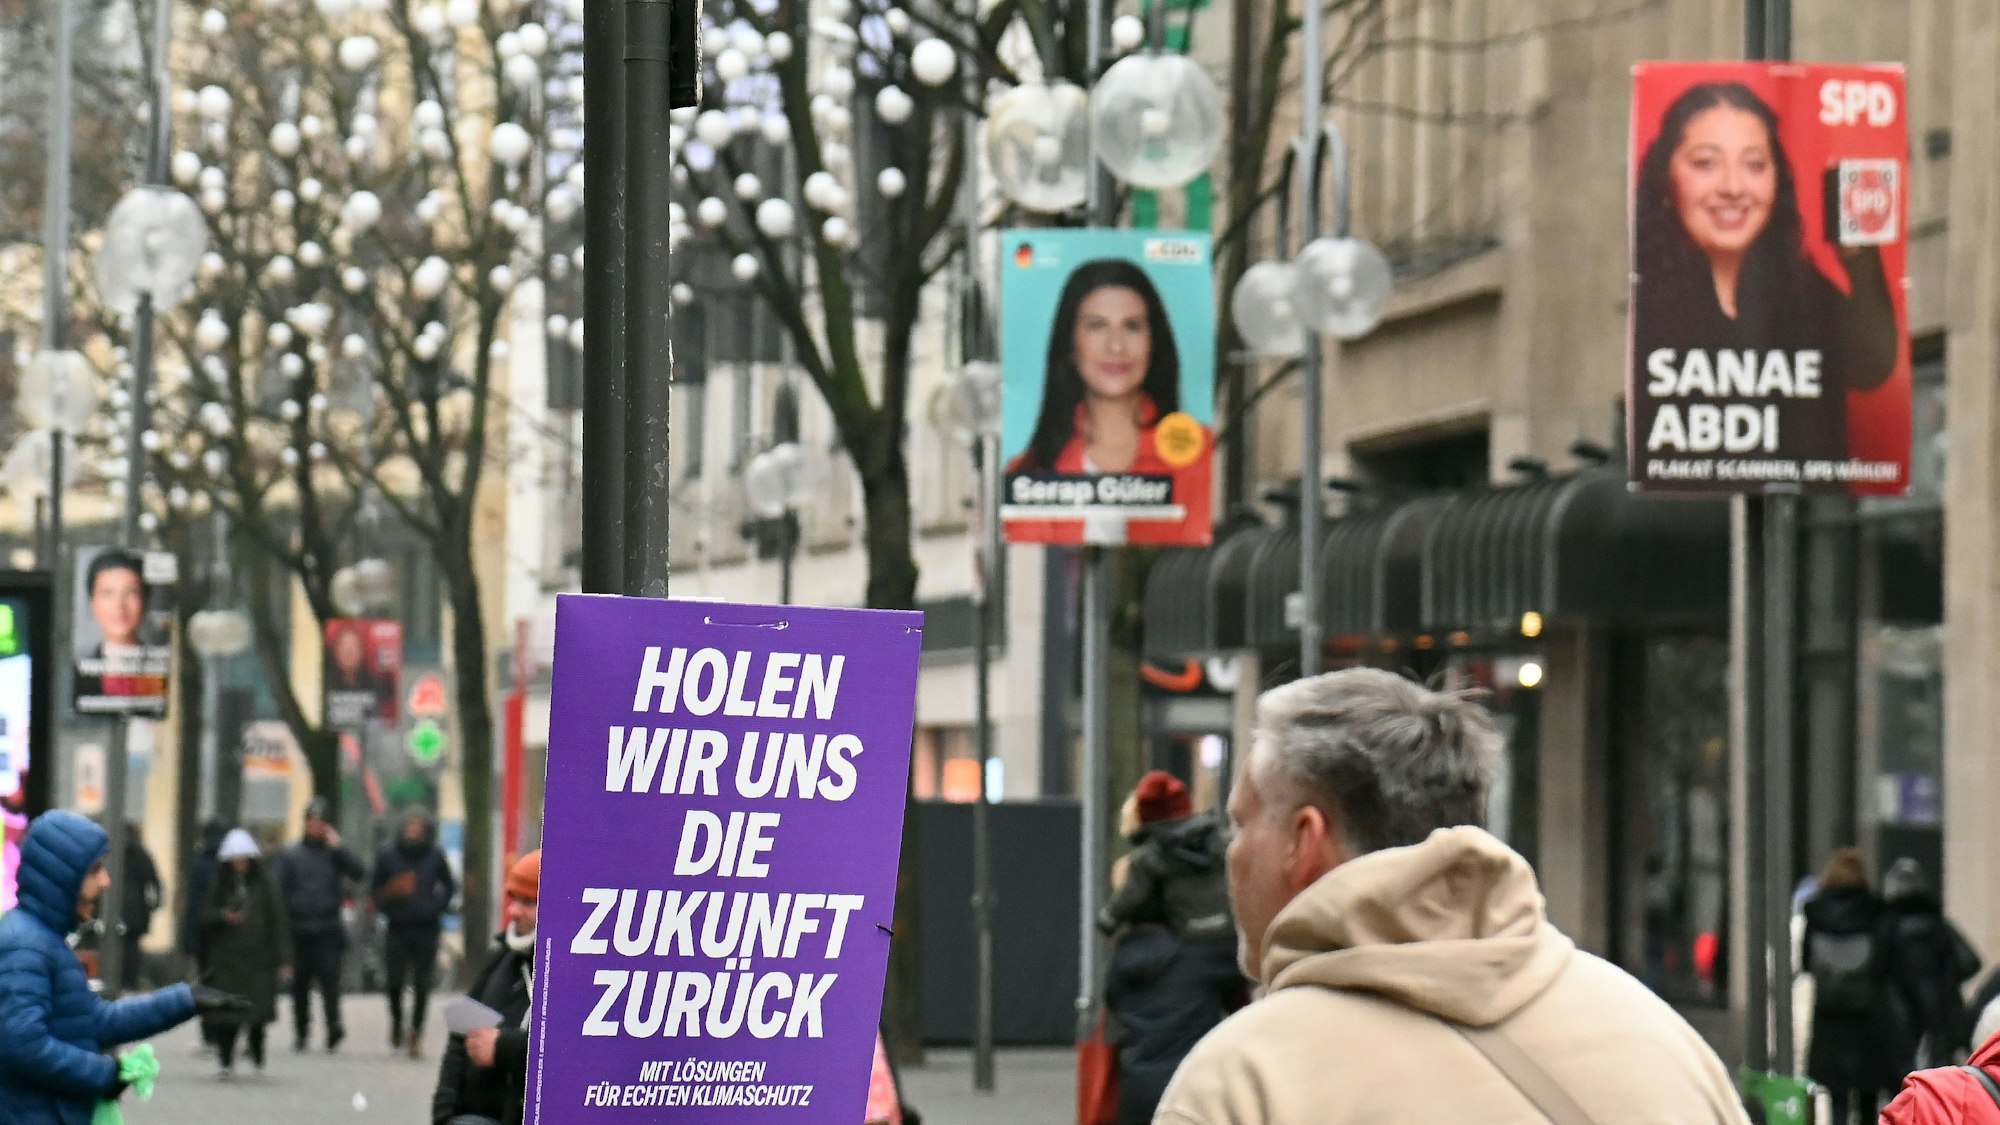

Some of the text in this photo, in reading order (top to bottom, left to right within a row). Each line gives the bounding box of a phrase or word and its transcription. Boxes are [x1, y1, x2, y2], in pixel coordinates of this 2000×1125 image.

[1819, 80, 1896, 127] SPD
[1647, 347, 1823, 398] SANAE
[1647, 403, 1779, 451] ABDI
[1012, 475, 1169, 506] Serap Güler
[1647, 459, 1713, 480] PLAKAT
[633, 646, 845, 720] HOLEN
[606, 726, 863, 801] WIR UNS
[674, 810, 780, 877] DIE
[570, 888, 864, 959] ZUKUNFT
[582, 957, 838, 1039] ZURÜCK
[584, 1080, 813, 1107] FÜR ECHTEN KLIMASCHUTZ
[639, 1057, 767, 1083] MIT LÖSUNGEN
